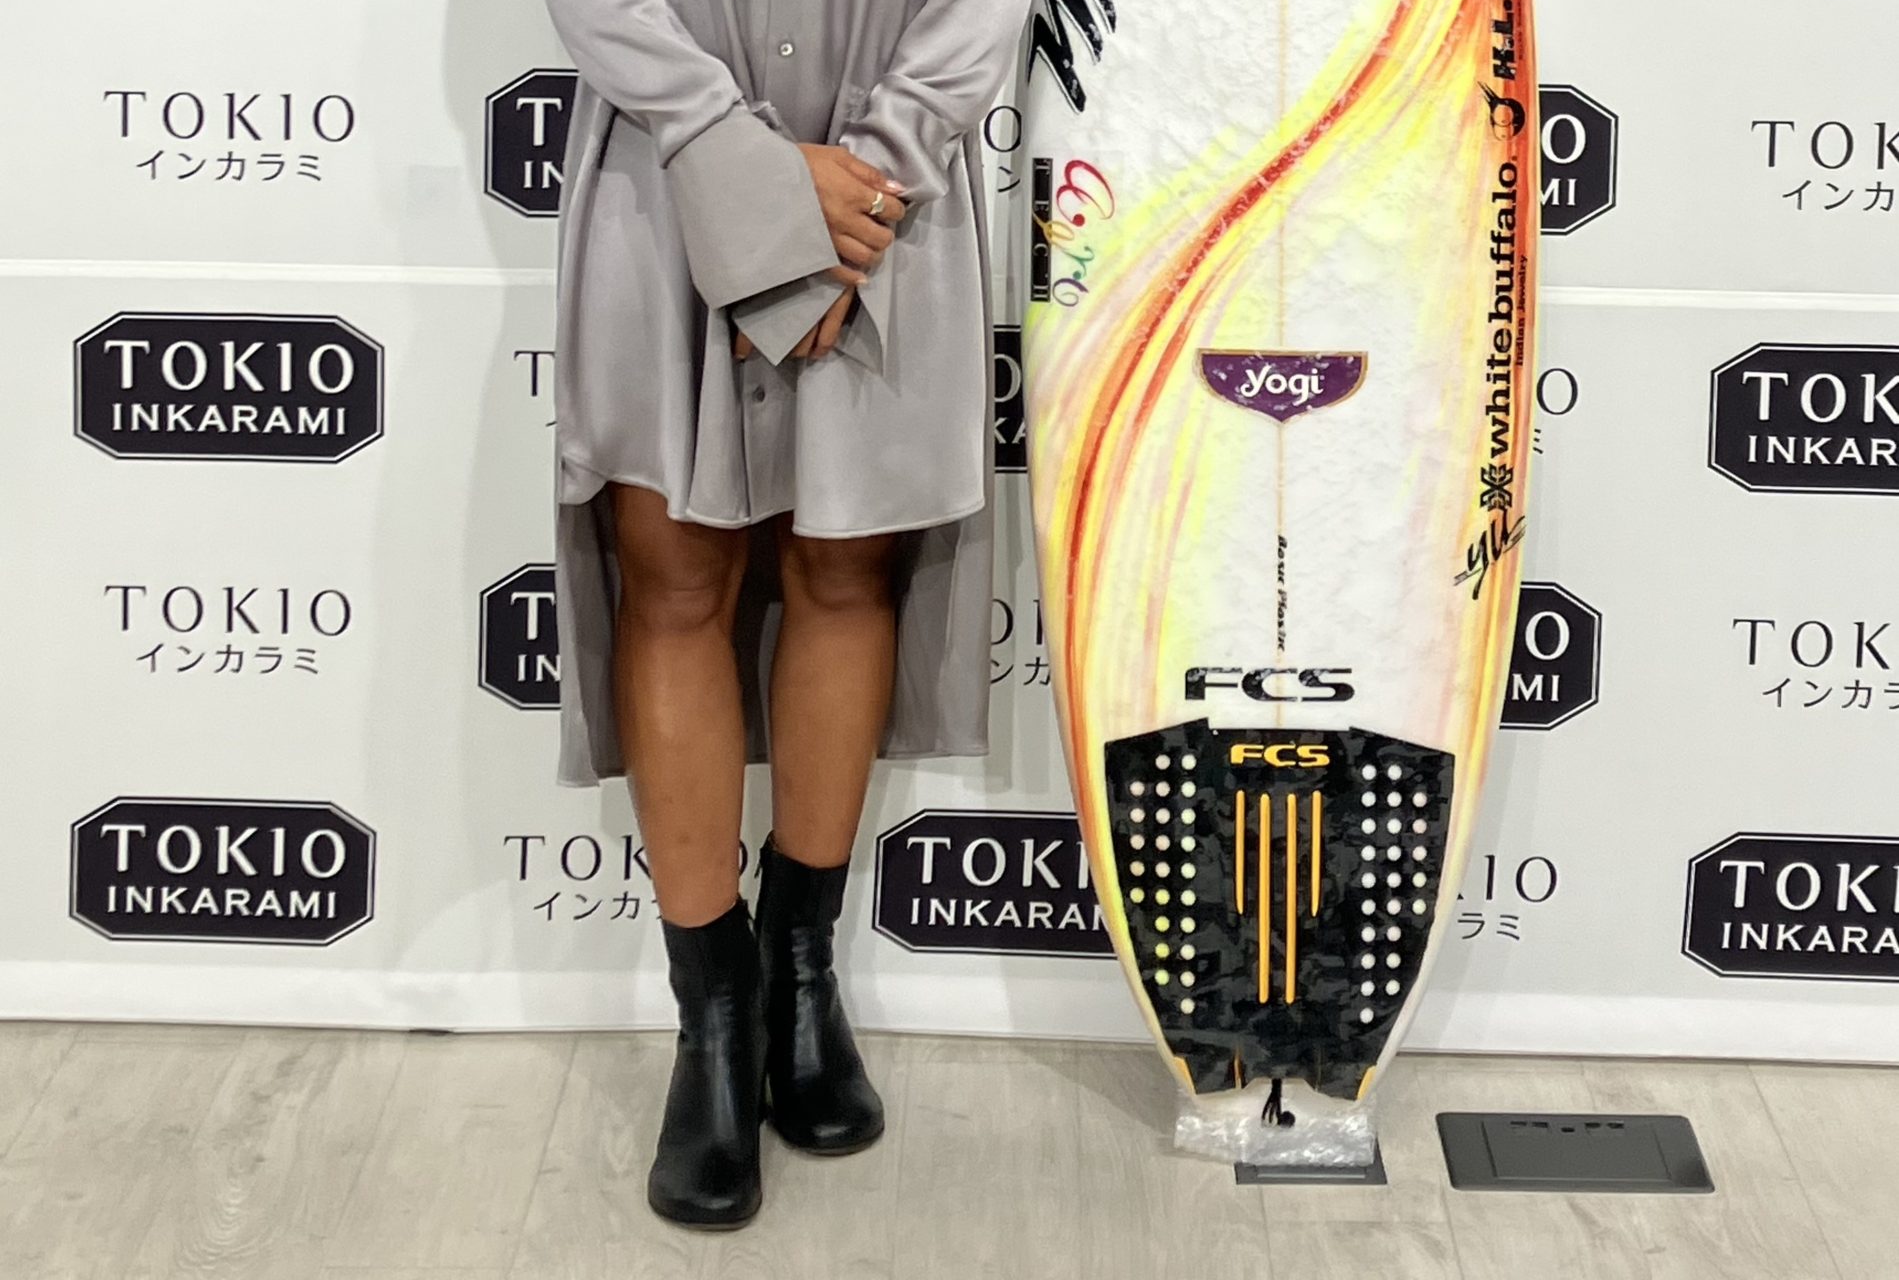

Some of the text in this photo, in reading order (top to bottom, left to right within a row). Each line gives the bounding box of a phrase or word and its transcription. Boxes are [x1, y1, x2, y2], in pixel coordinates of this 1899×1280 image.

[103, 90, 355, 143] TOKIO
[136, 150, 322, 182] インカラミ
[104, 339, 354, 394] TOKIO
[112, 403, 345, 435] INKARAMI
[104, 585, 351, 637] TOKIO
[136, 643, 319, 675] インカラミ
[1185, 667, 1355, 702] FCS
[1230, 744, 1330, 767] FCS
[101, 824, 346, 878] TOKIO
[107, 885, 336, 919] INKARAMI
